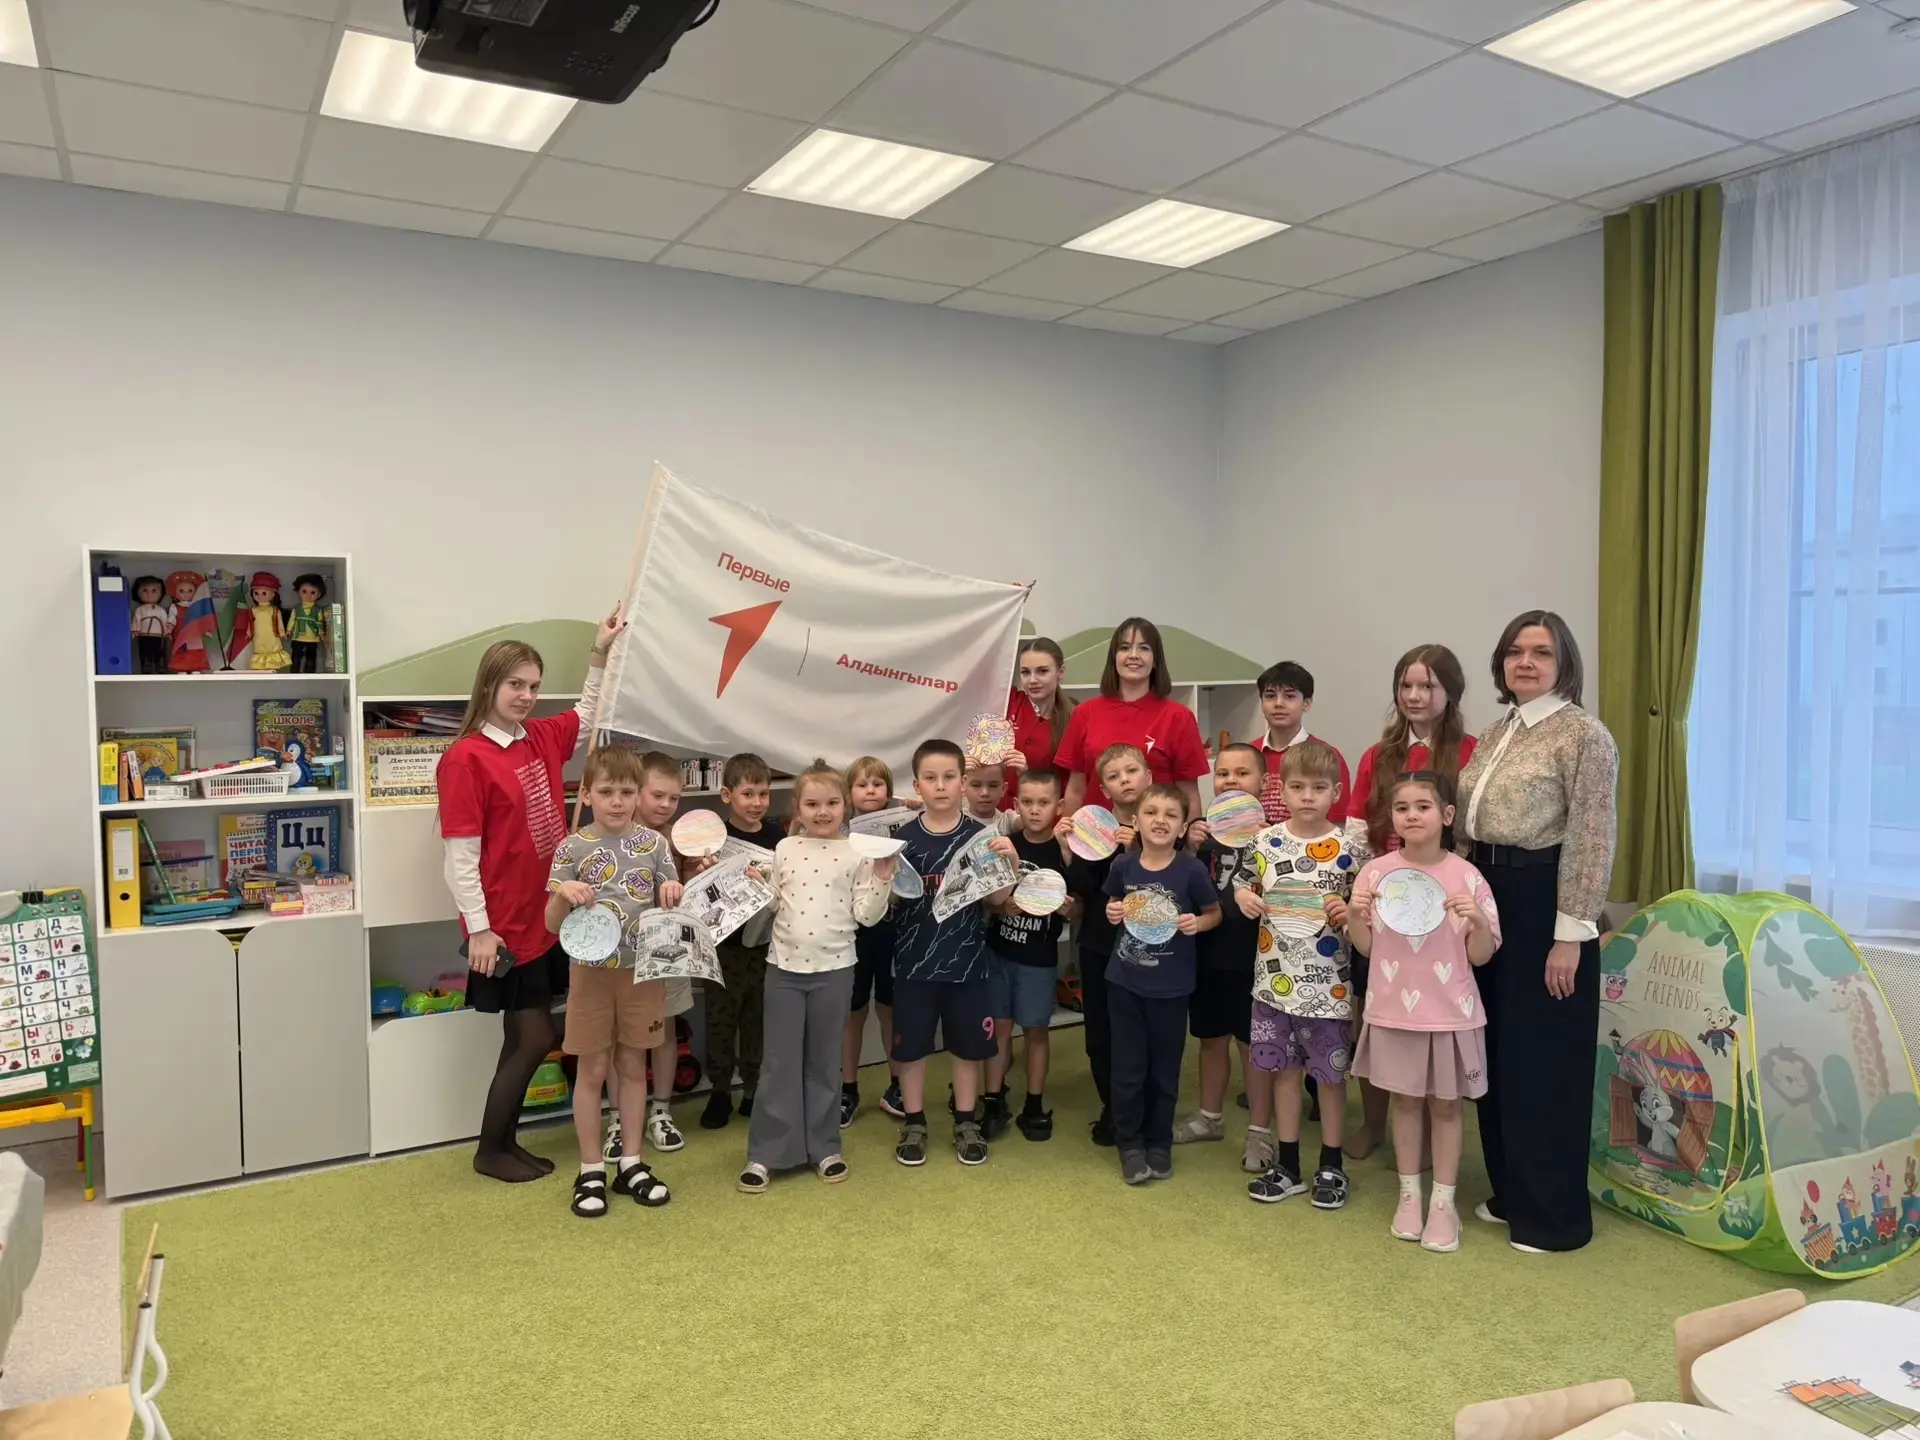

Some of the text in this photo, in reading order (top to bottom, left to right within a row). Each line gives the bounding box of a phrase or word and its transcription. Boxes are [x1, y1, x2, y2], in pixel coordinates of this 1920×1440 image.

[717, 552, 791, 592] Первые
[836, 653, 959, 693] Алдынгылар
[281, 822, 325, 850] Цц
[17, 924, 24, 934] Г
[51, 919, 62, 931] Д
[1000, 924, 1028, 944] BEAR
[18, 944, 28, 955] З
[54, 939, 64, 949] И
[21, 965, 33, 976] М
[57, 959, 66, 970] Н
[1647, 951, 1704, 984] ANIMAL
[60, 980, 68, 990] Т
[23, 986, 33, 997] С
[1644, 980, 1701, 1012] FRIENDS
[62, 1001, 71, 1010] Ч
[26, 1007, 36, 1019] Ц
[27, 1027, 39, 1039] Ы
[982, 1016, 995, 1040] 9
[31, 1048, 40, 1060] Я
